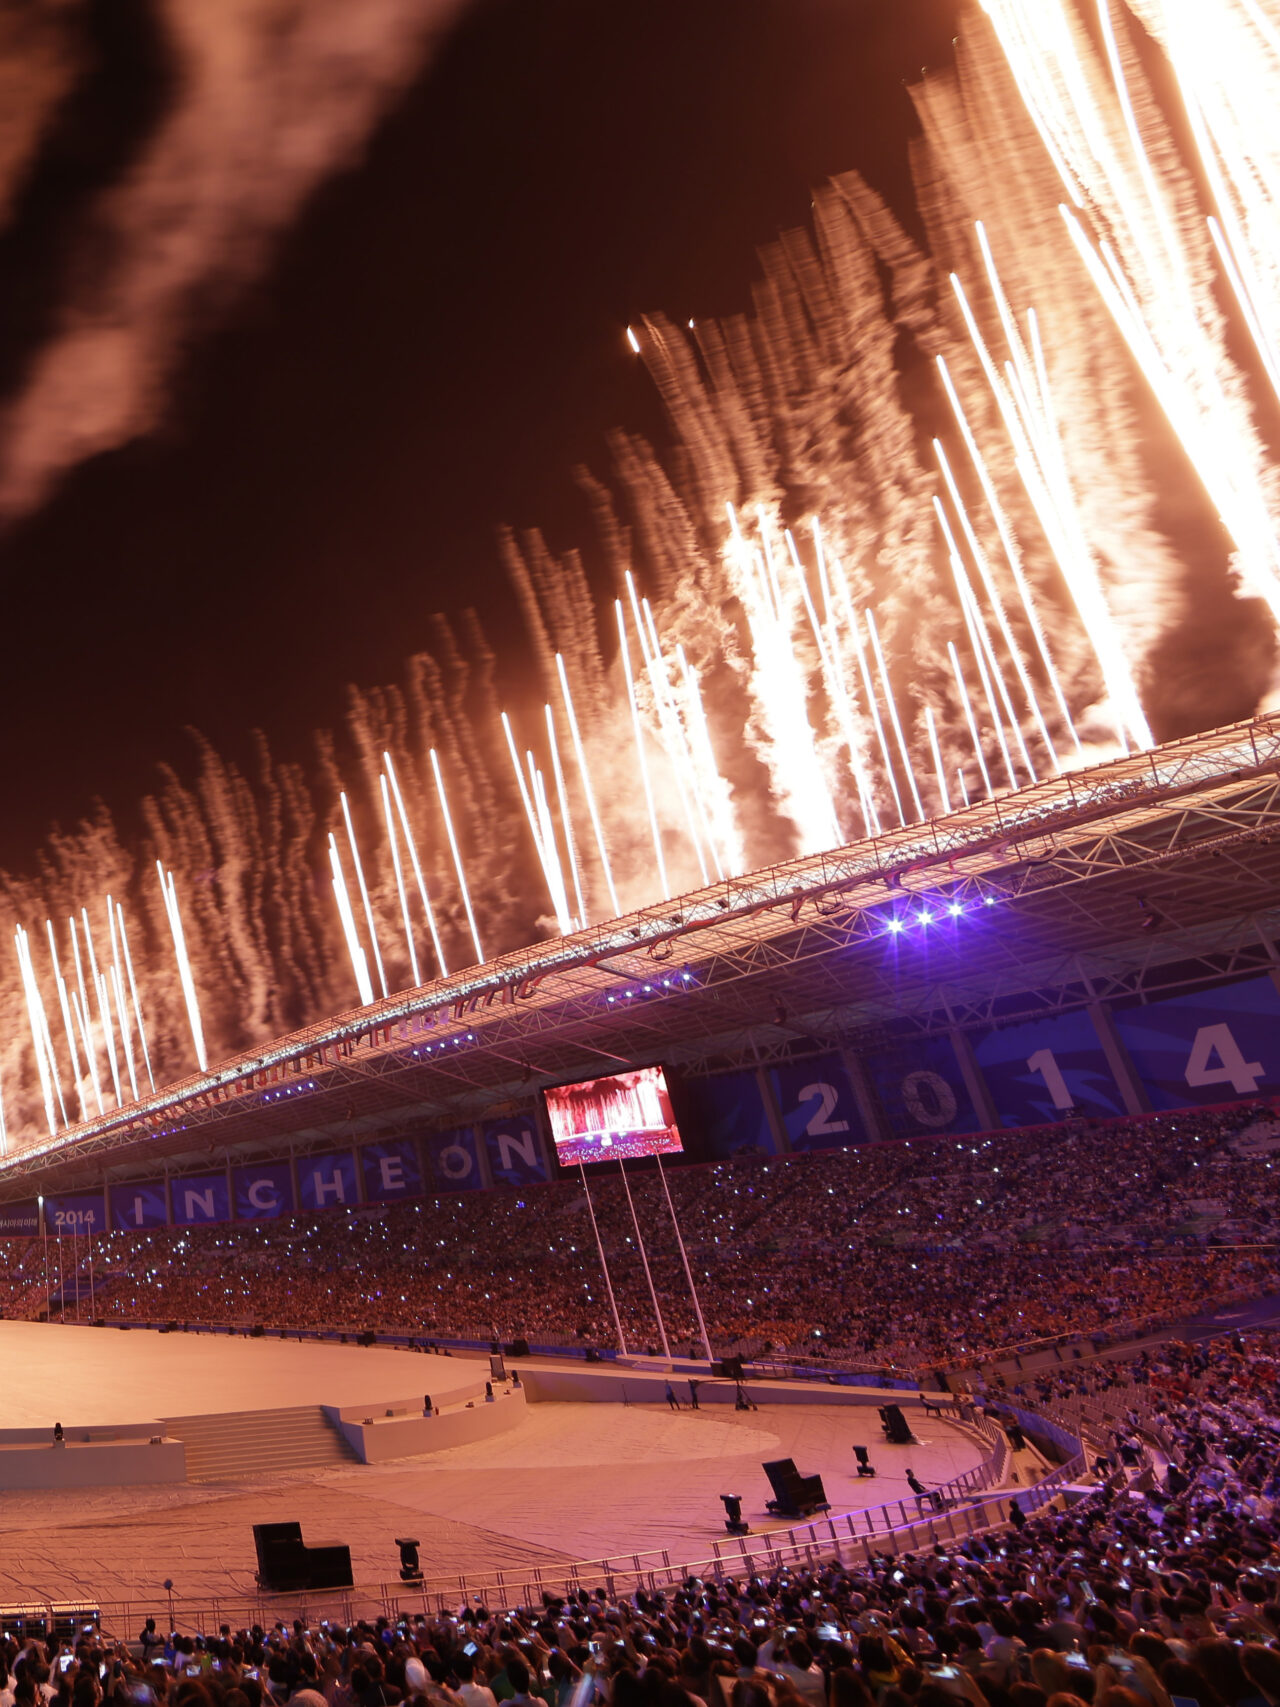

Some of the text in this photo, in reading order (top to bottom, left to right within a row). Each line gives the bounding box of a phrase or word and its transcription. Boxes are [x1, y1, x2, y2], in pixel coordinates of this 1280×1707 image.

[134, 1022, 1267, 1225] INCHEON 2014
[55, 1210, 95, 1225] 2014
